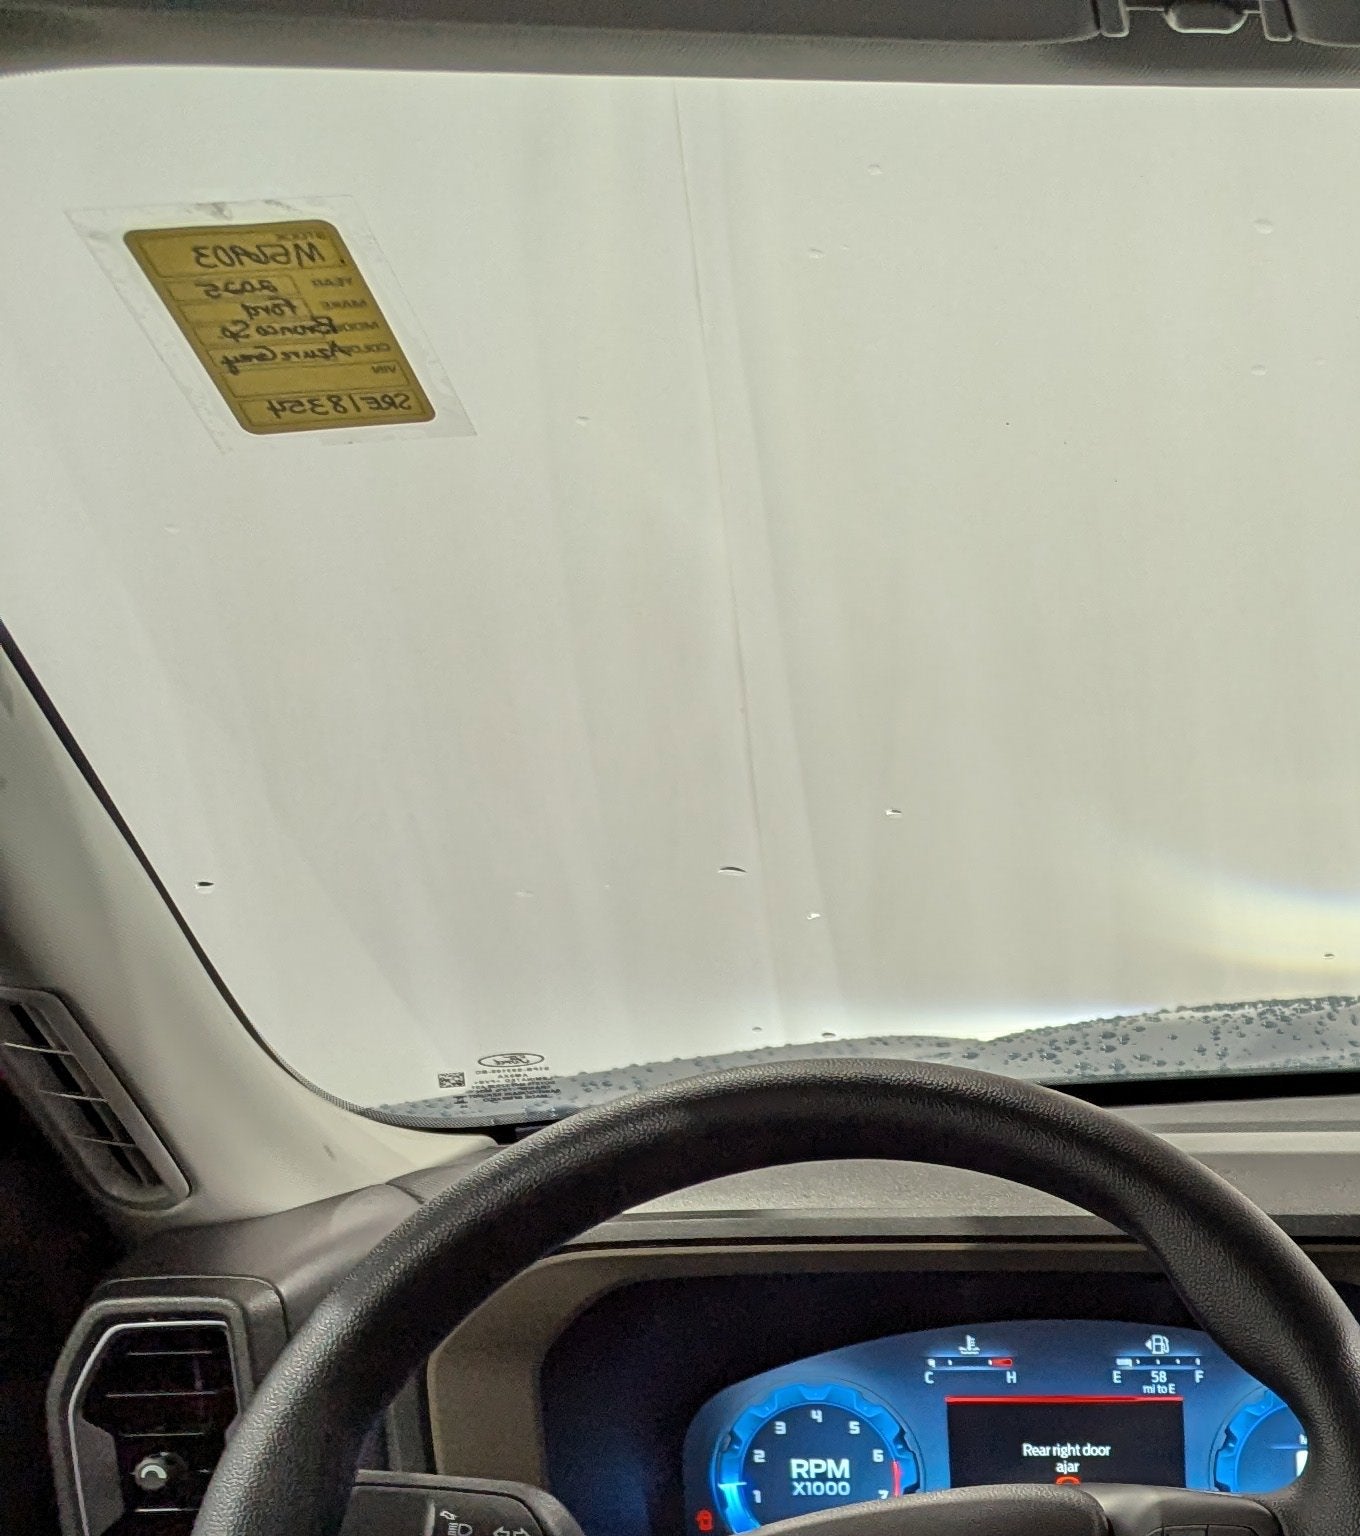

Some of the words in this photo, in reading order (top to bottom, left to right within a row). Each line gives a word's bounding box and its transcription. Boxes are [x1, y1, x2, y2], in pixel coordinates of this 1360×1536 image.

[924, 1371, 935, 1385] C
[1006, 1371, 1017, 1384] H
[1112, 1371, 1122, 1384] E
[1151, 1371, 1167, 1383] 58
[1194, 1371, 1204, 1384] F
[1157, 1384, 1168, 1394] to
[1168, 1384, 1176, 1394] E
[811, 1410, 822, 1423] 4
[774, 1421, 787, 1435] 3
[849, 1421, 860, 1435] 5
[753, 1449, 765, 1463] 2
[872, 1449, 883, 1463] 6
[1022, 1443, 1051, 1457] Rear
[1052, 1443, 1081, 1460] right
[1082, 1443, 1111, 1457] door
[790, 1458, 850, 1479] RPM
[1055, 1460, 1080, 1475] ajar
[792, 1481, 850, 1496] X1000
[752, 1490, 762, 1503] 1
